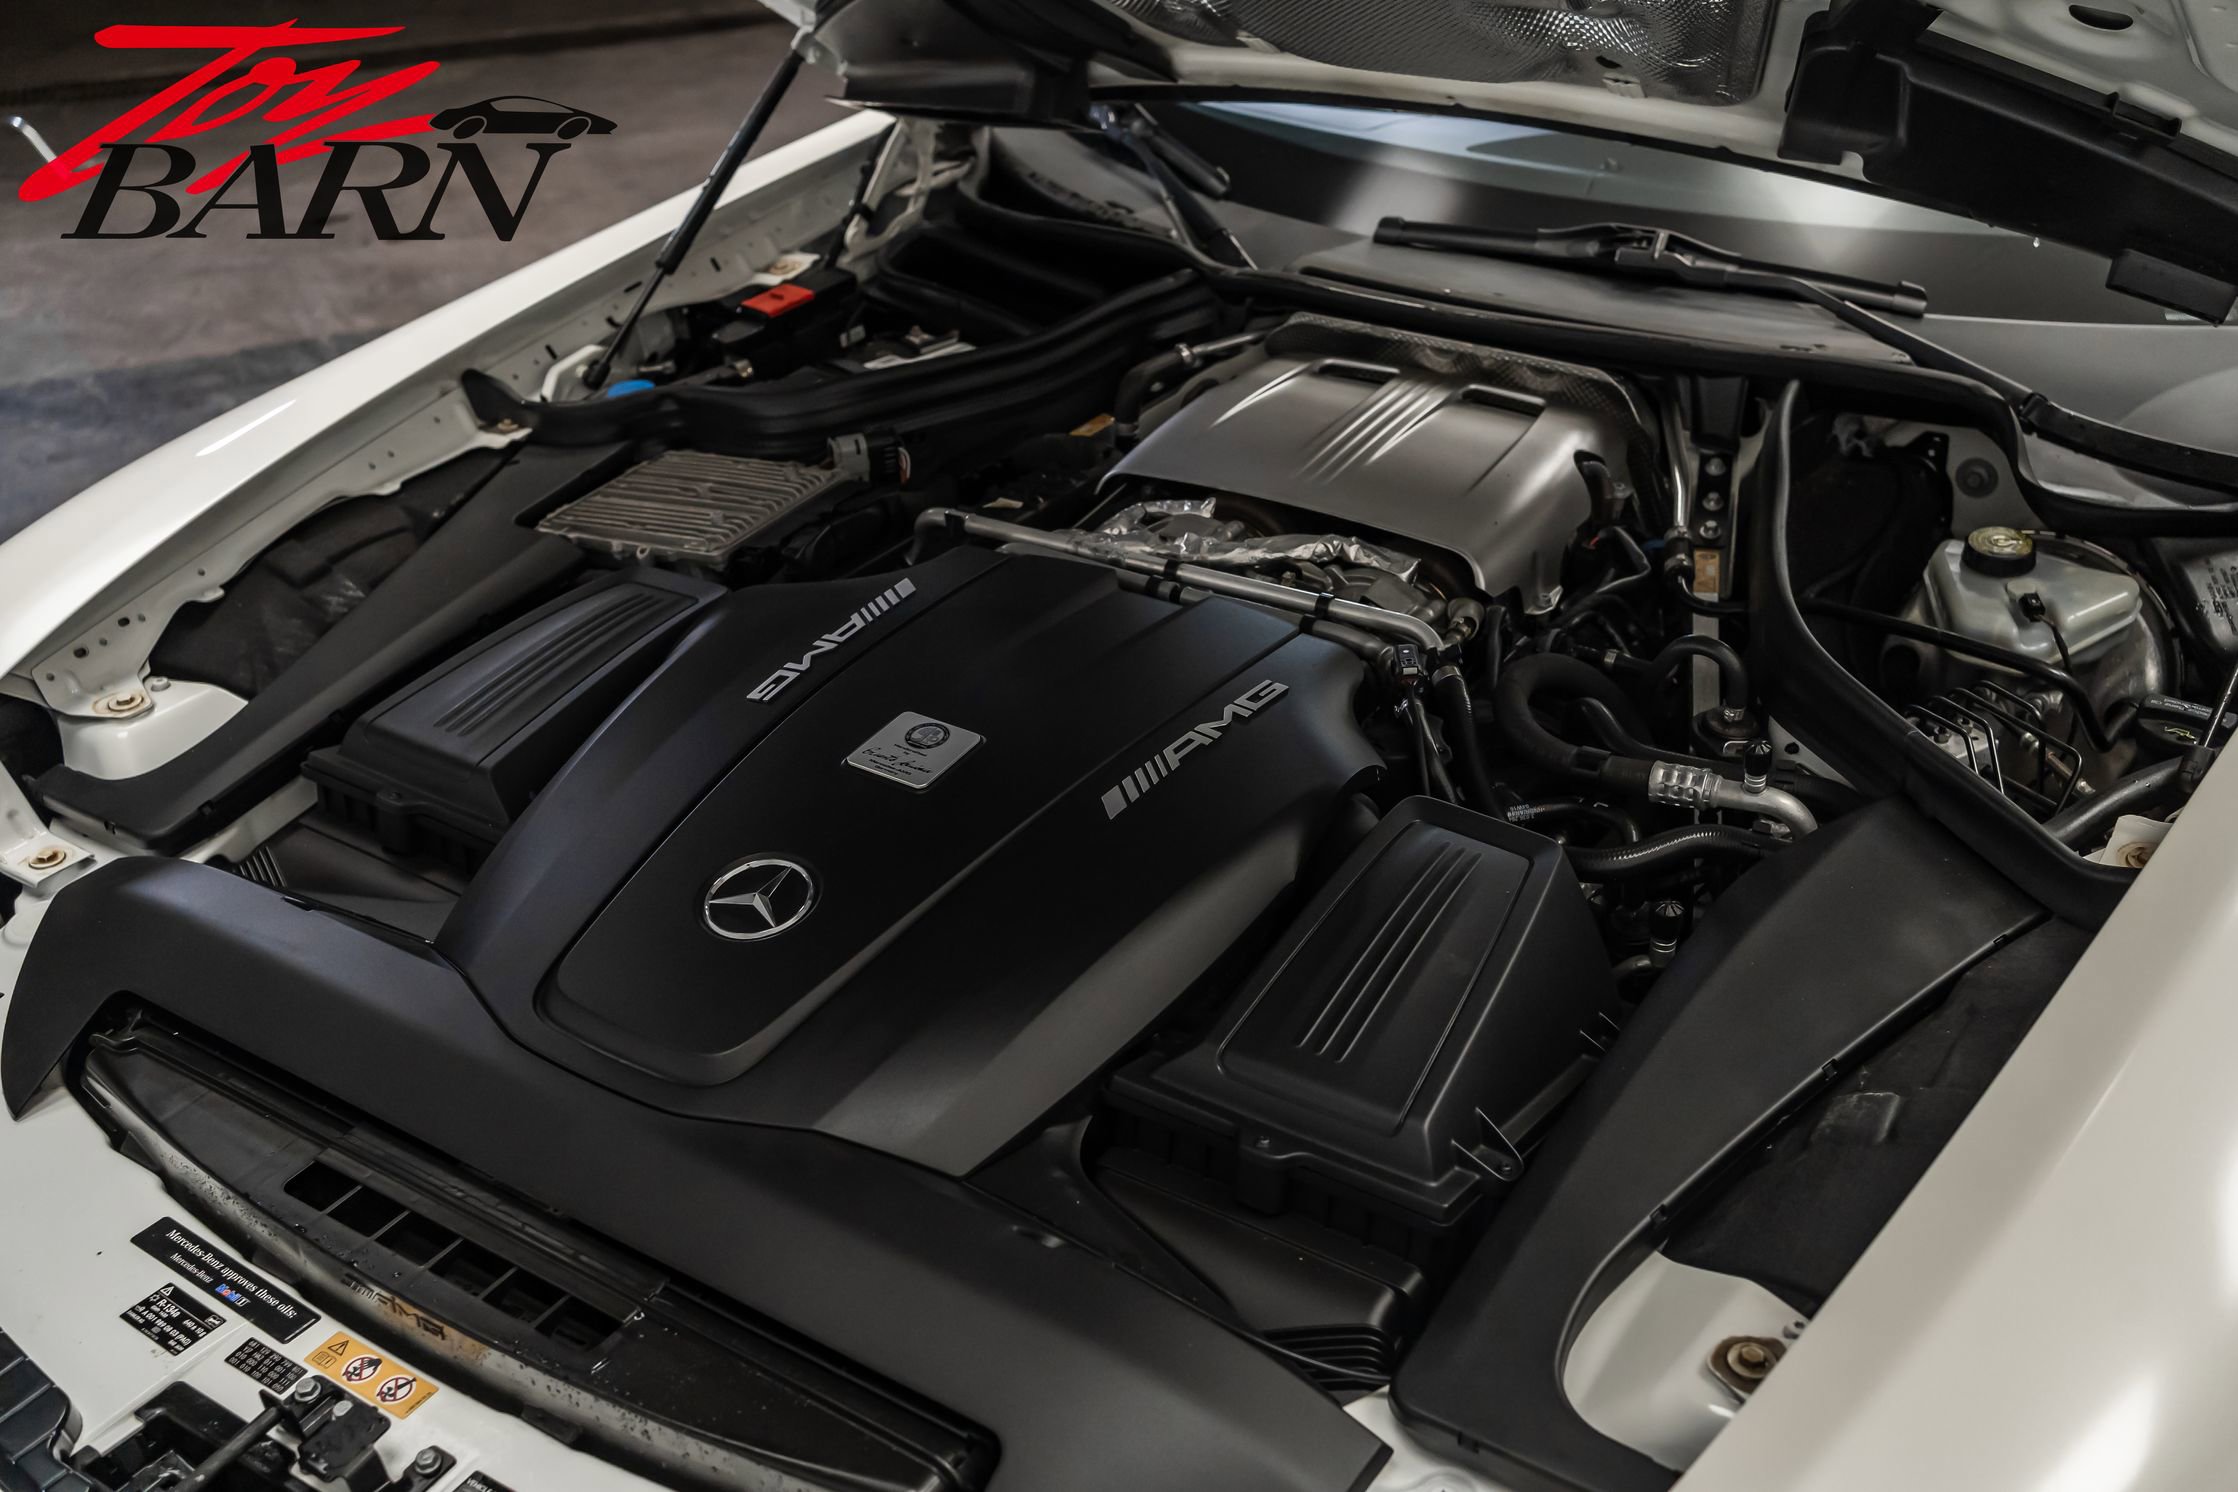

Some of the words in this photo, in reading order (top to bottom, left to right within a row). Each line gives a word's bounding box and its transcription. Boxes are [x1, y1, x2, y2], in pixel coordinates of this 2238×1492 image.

[166, 1230, 224, 1270] Mercedes-Benz
[221, 1268, 258, 1292] approves
[255, 1289, 279, 1306] these
[170, 1253, 213, 1283] Mercedes-Benz
[156, 1299, 180, 1317] R-134a
